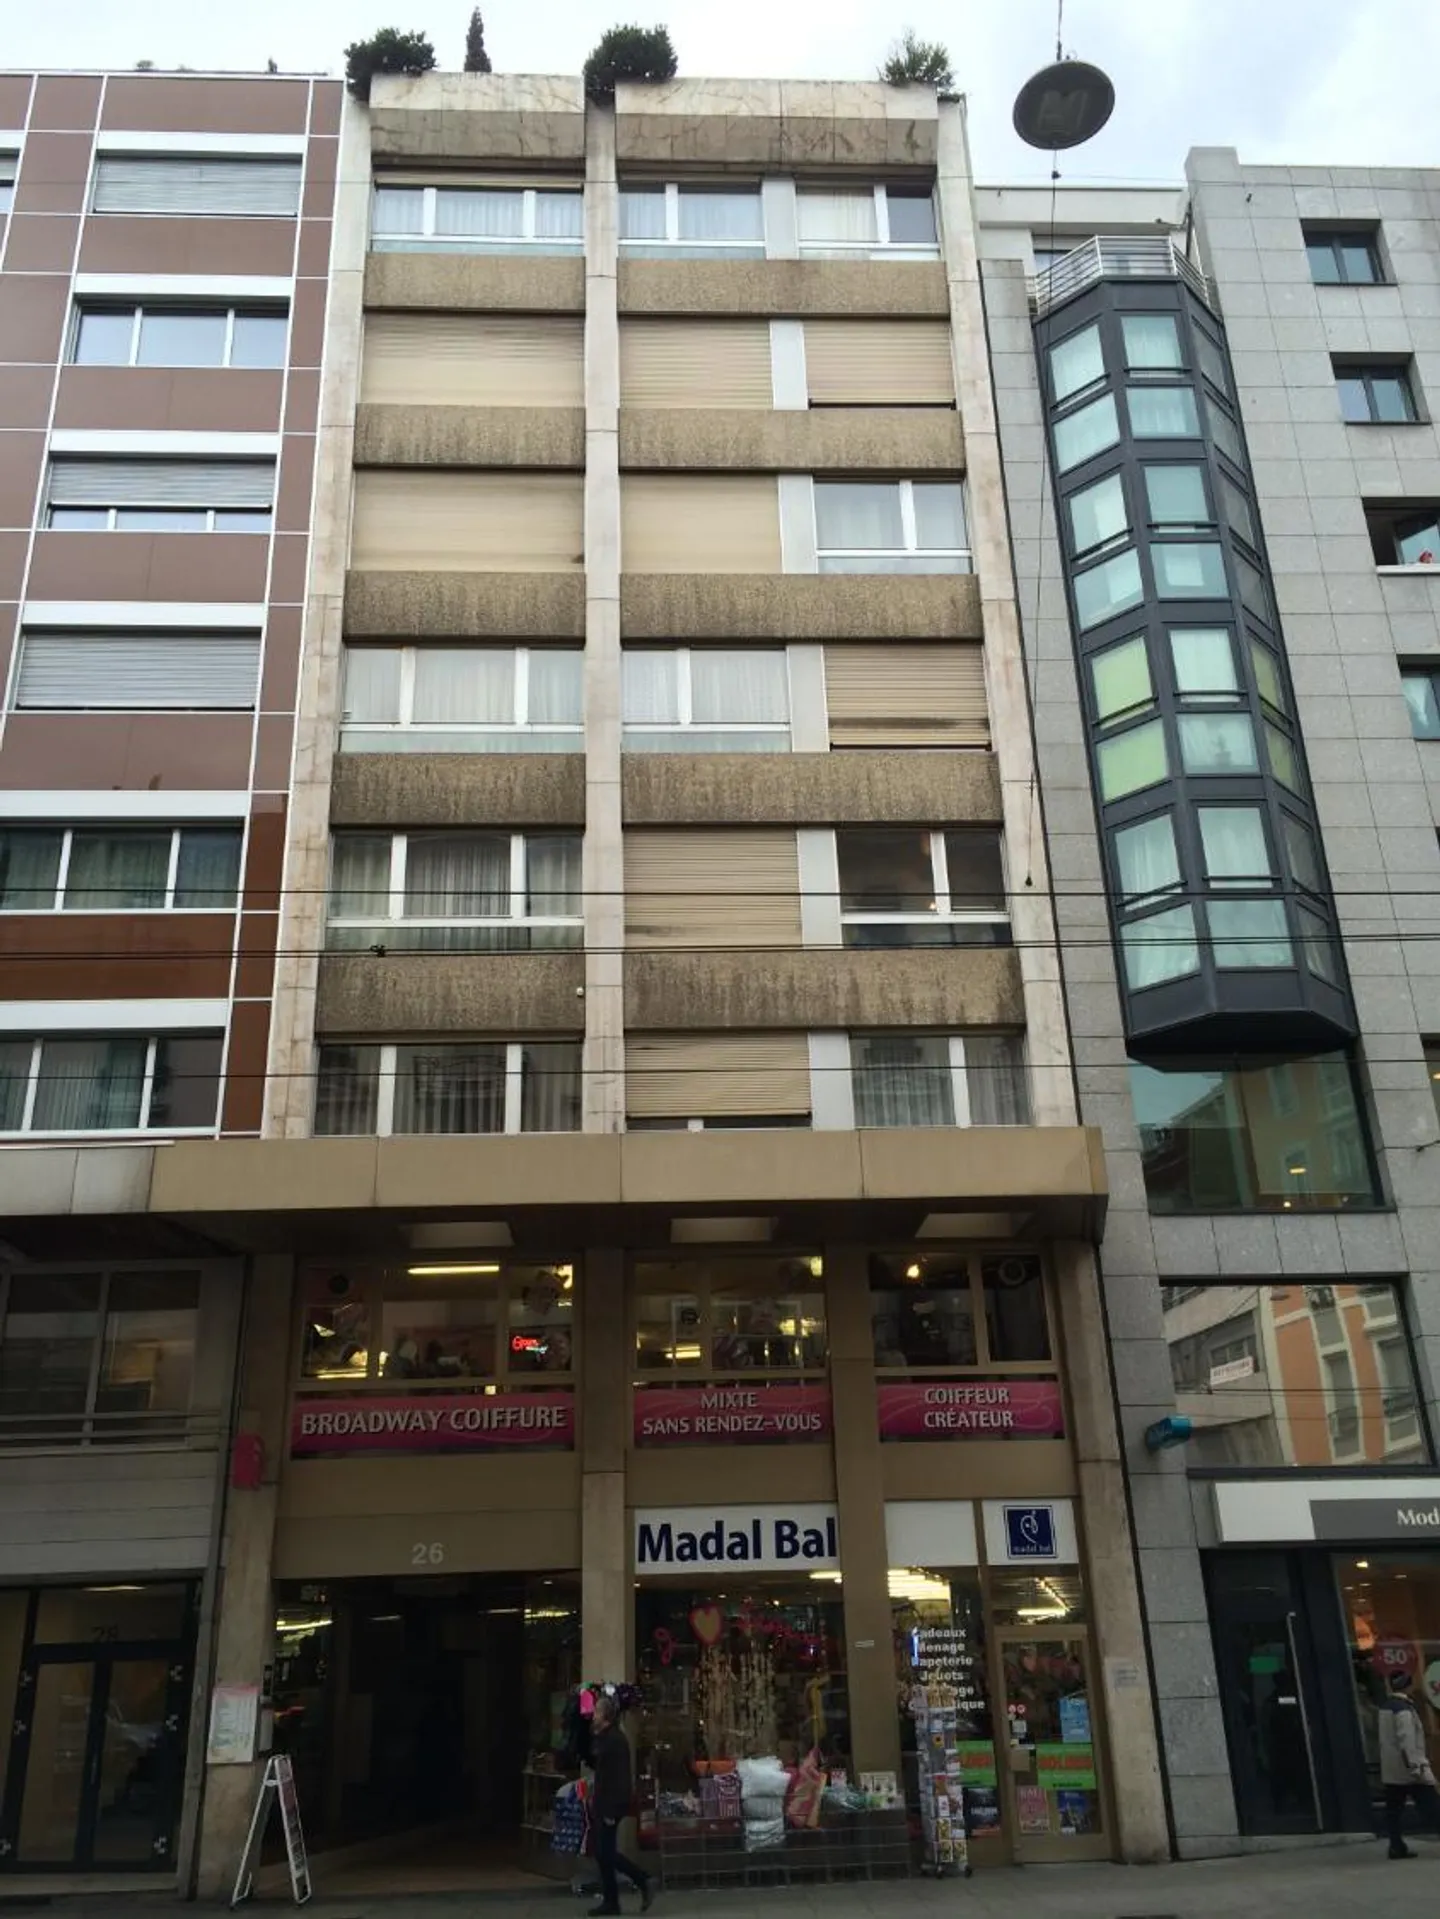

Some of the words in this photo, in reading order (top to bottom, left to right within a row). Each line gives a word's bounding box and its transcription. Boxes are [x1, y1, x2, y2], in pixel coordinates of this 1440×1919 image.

[700, 1391, 757, 1409] MIXTE
[924, 1387, 1010, 1406] COIFFEUR
[301, 1409, 443, 1436] BROADWAY
[450, 1406, 567, 1430] COIFFURE
[642, 1416, 689, 1435] SANS
[695, 1413, 822, 1433] RENDEZ-VOUS
[924, 1407, 1014, 1429] CRÉATEUR
[1397, 1506, 1440, 1526] Mod
[637, 1518, 761, 1564] Madal
[774, 1517, 837, 1560] Bal
[411, 1543, 444, 1565] 26
